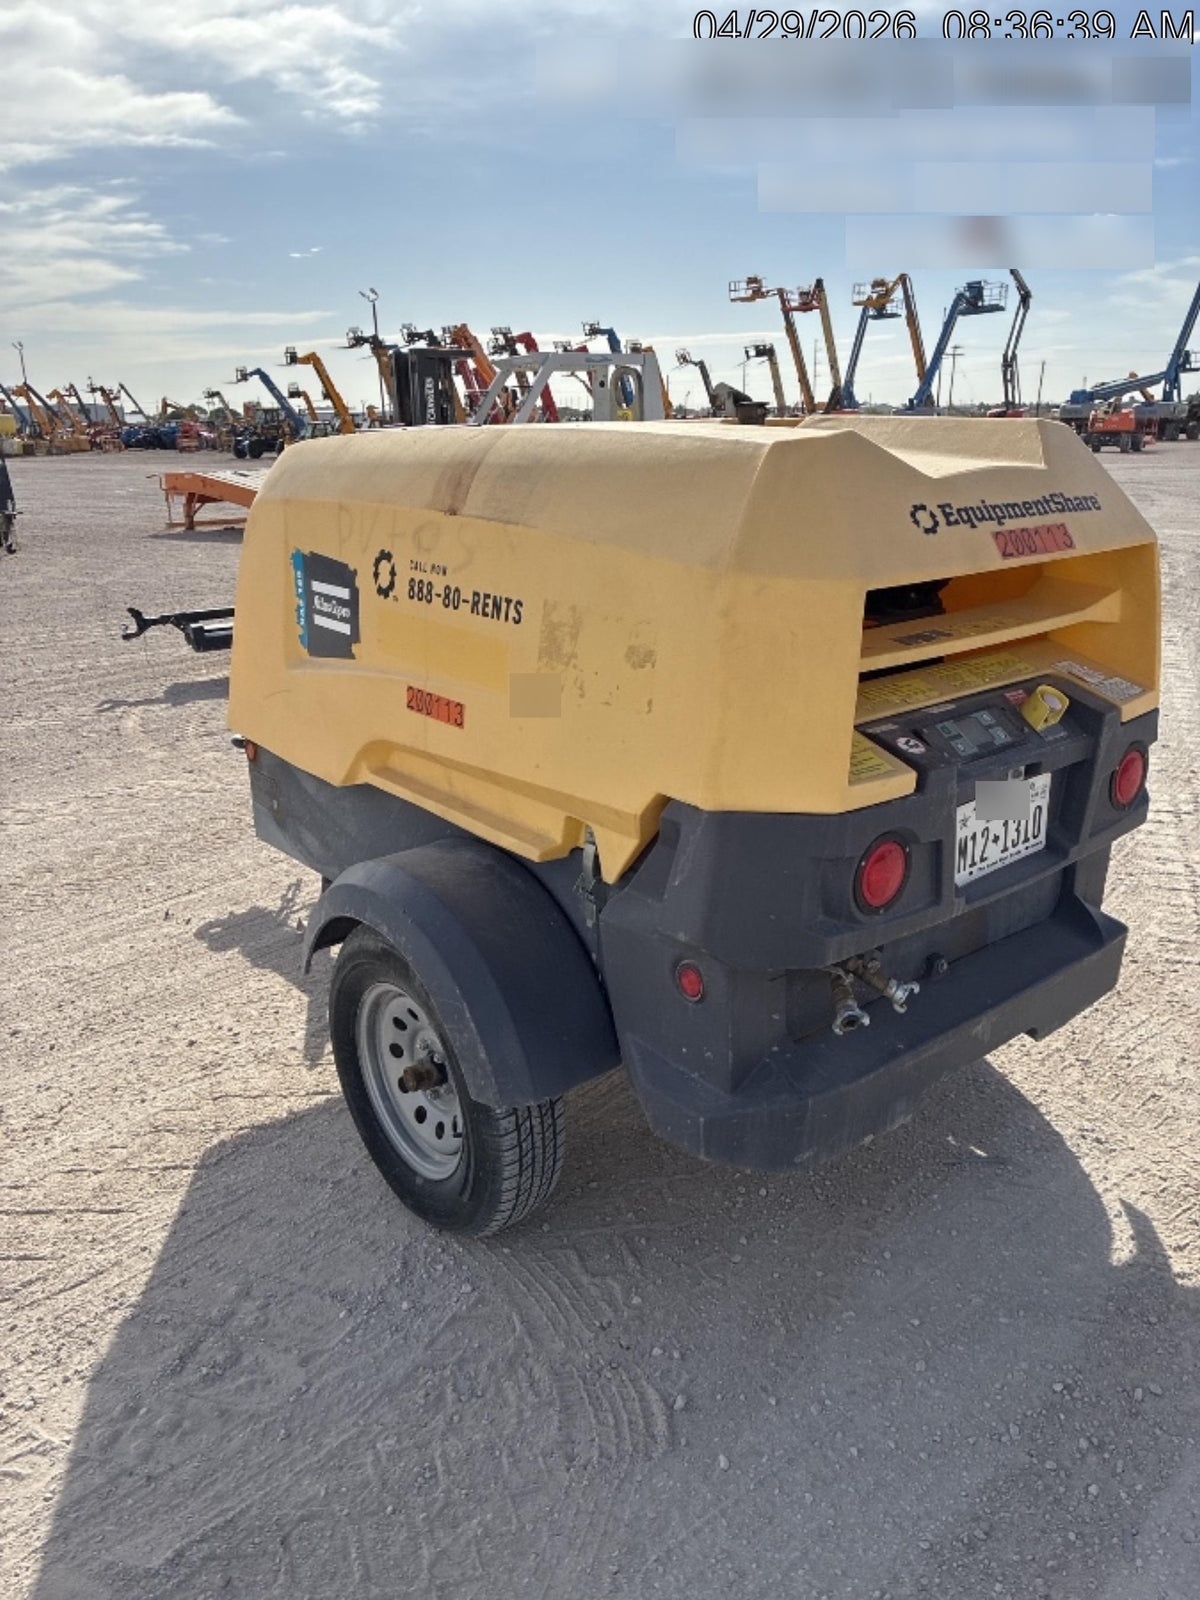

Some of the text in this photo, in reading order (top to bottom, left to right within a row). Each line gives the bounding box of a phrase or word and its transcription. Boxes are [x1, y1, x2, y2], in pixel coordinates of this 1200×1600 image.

[937, 492, 1102, 528] EquipmentShare
[995, 523, 1074, 557] 200113
[407, 577, 523, 625] 888-80-RENTS
[406, 686, 465, 727] 200113
